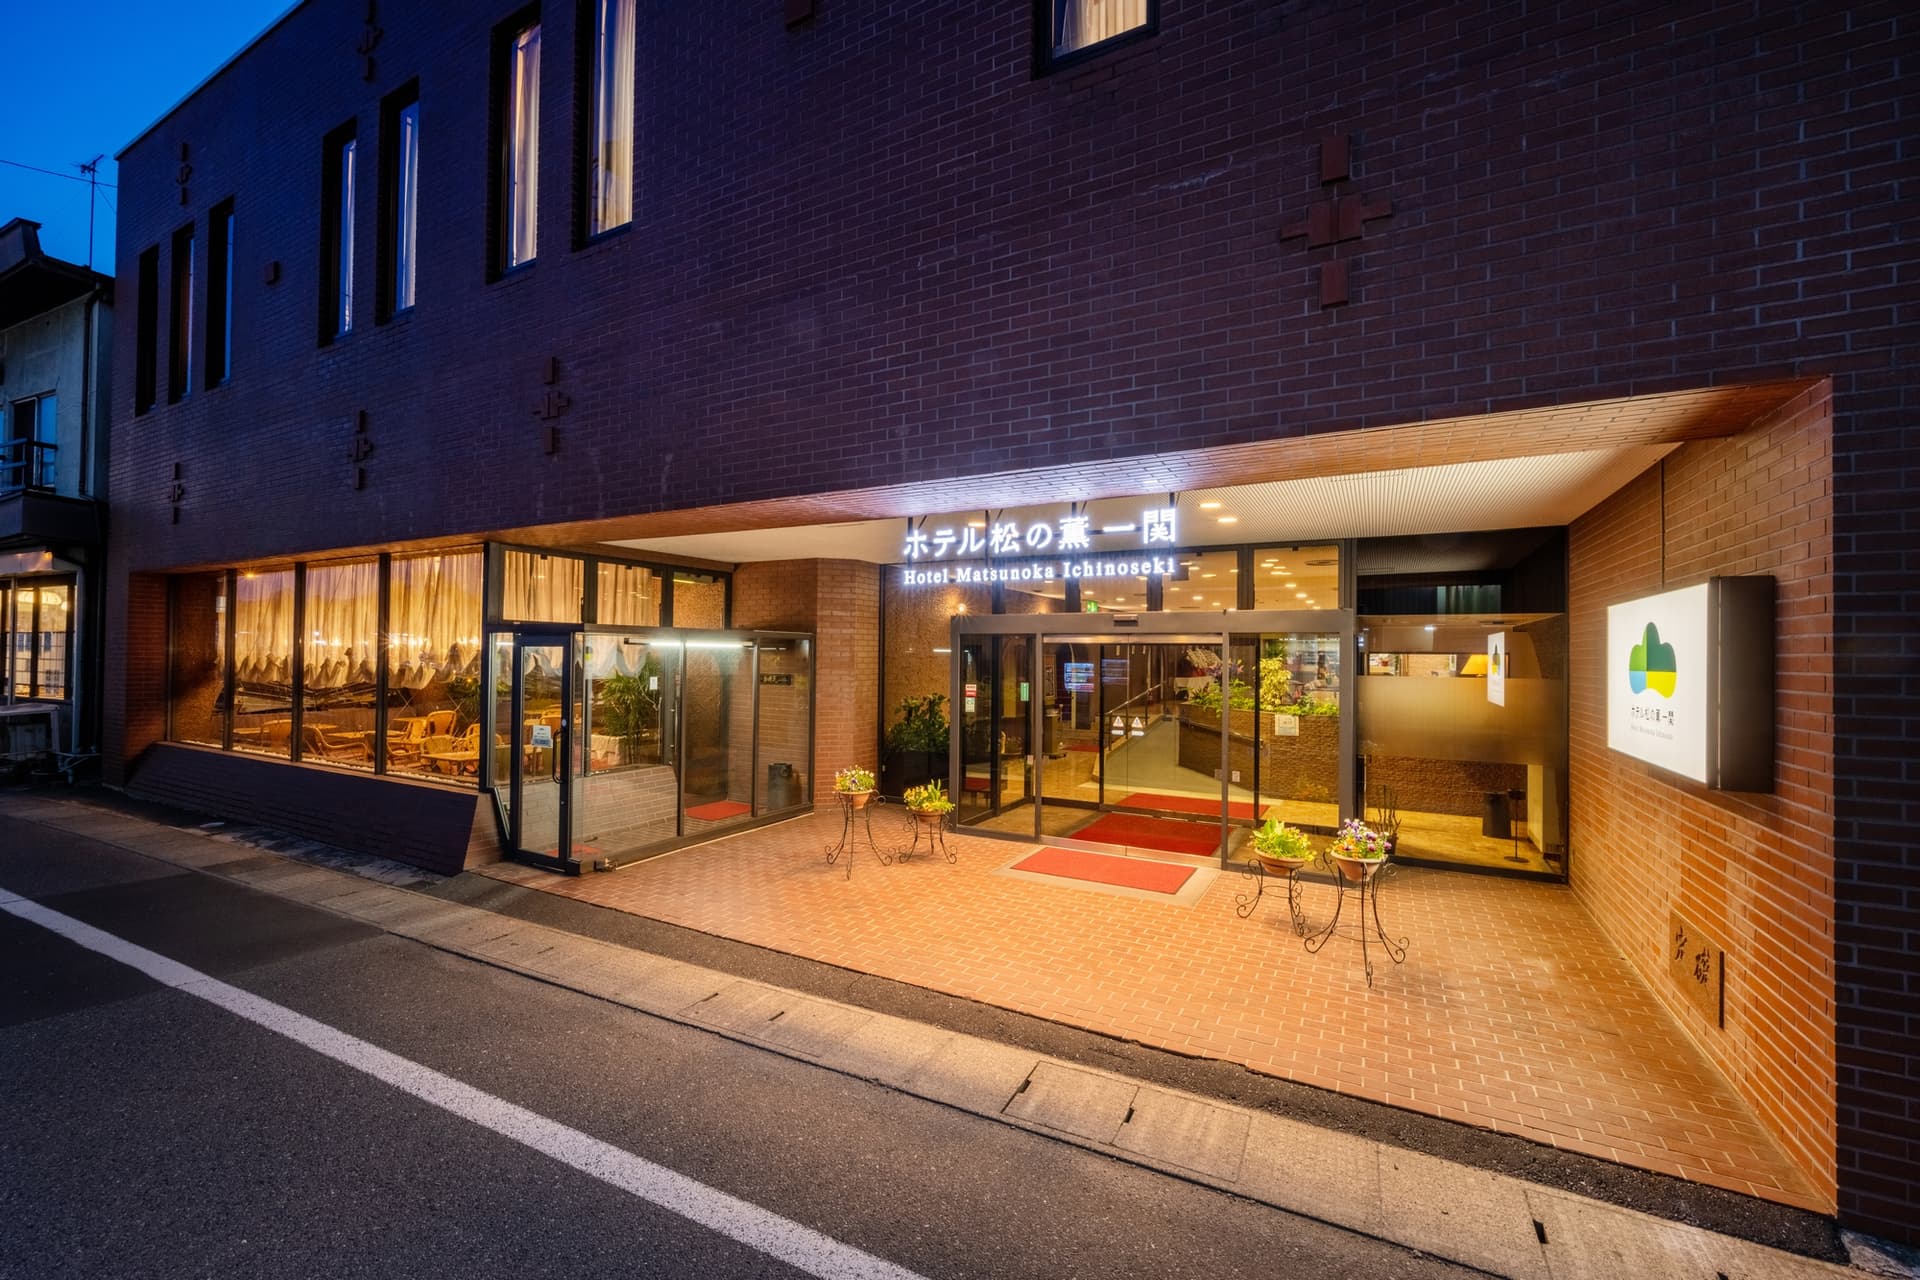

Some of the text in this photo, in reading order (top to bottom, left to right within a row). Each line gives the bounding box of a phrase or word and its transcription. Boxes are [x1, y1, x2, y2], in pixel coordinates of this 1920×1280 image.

[903, 508, 1177, 559] ホテル松の薫一関
[903, 557, 1176, 585] Hotel Matsunoka Ichinoseki
